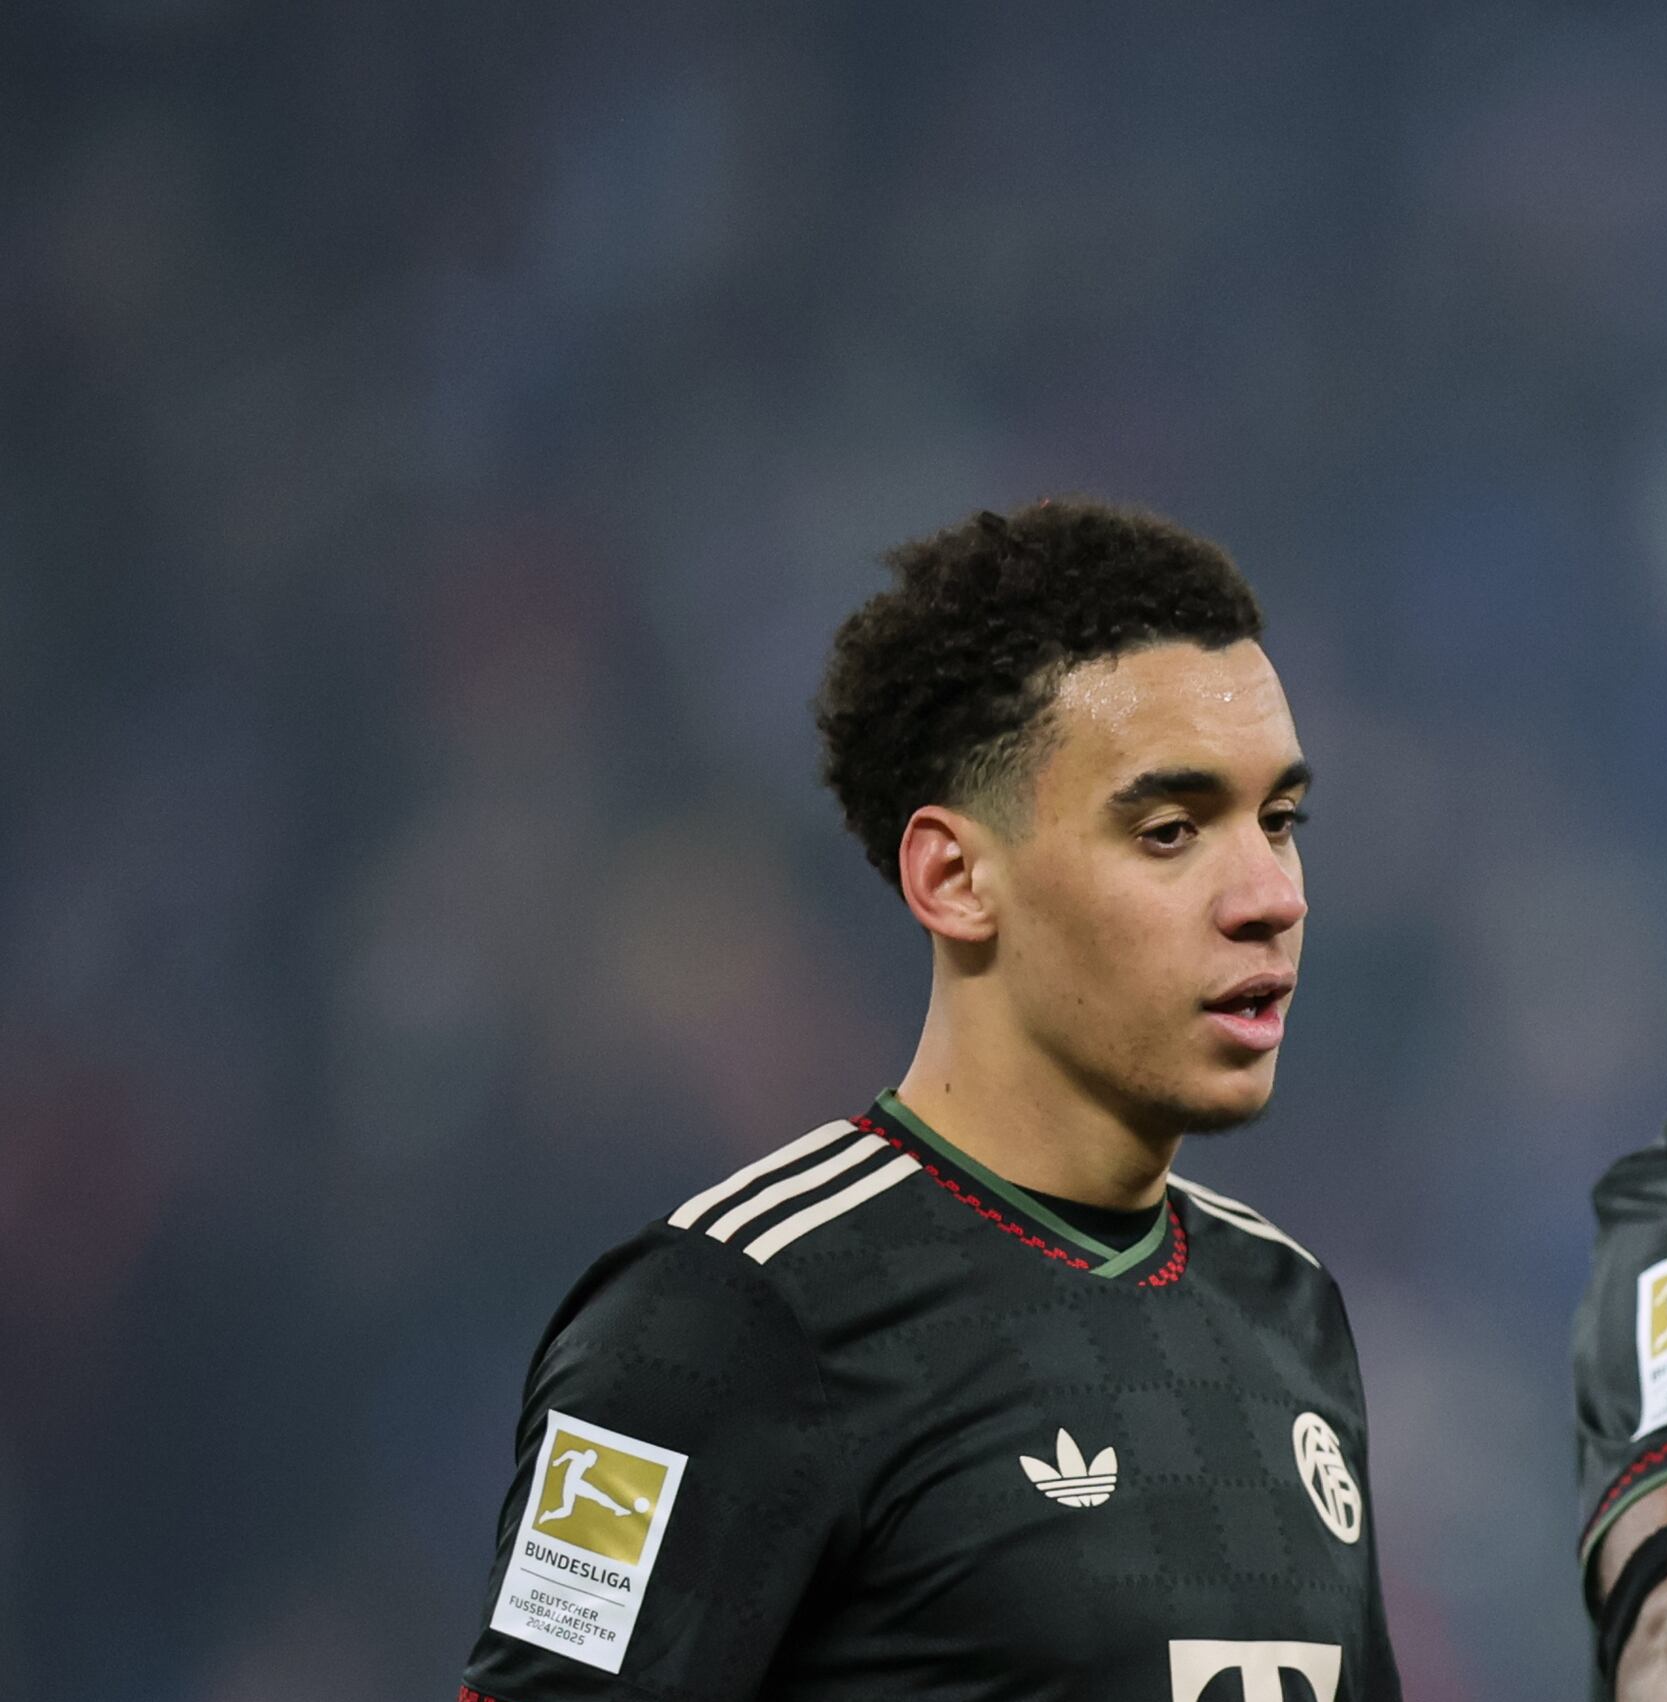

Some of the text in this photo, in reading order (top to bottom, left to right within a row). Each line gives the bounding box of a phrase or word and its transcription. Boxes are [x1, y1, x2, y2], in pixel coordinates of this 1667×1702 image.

[525, 1541, 631, 1592] BUNDESLIGA
[509, 1595, 616, 1642] FUSSBALLMEISTER
[531, 1589, 599, 1621] DEUTSCHER
[526, 1616, 586, 1646] 2024/2025
